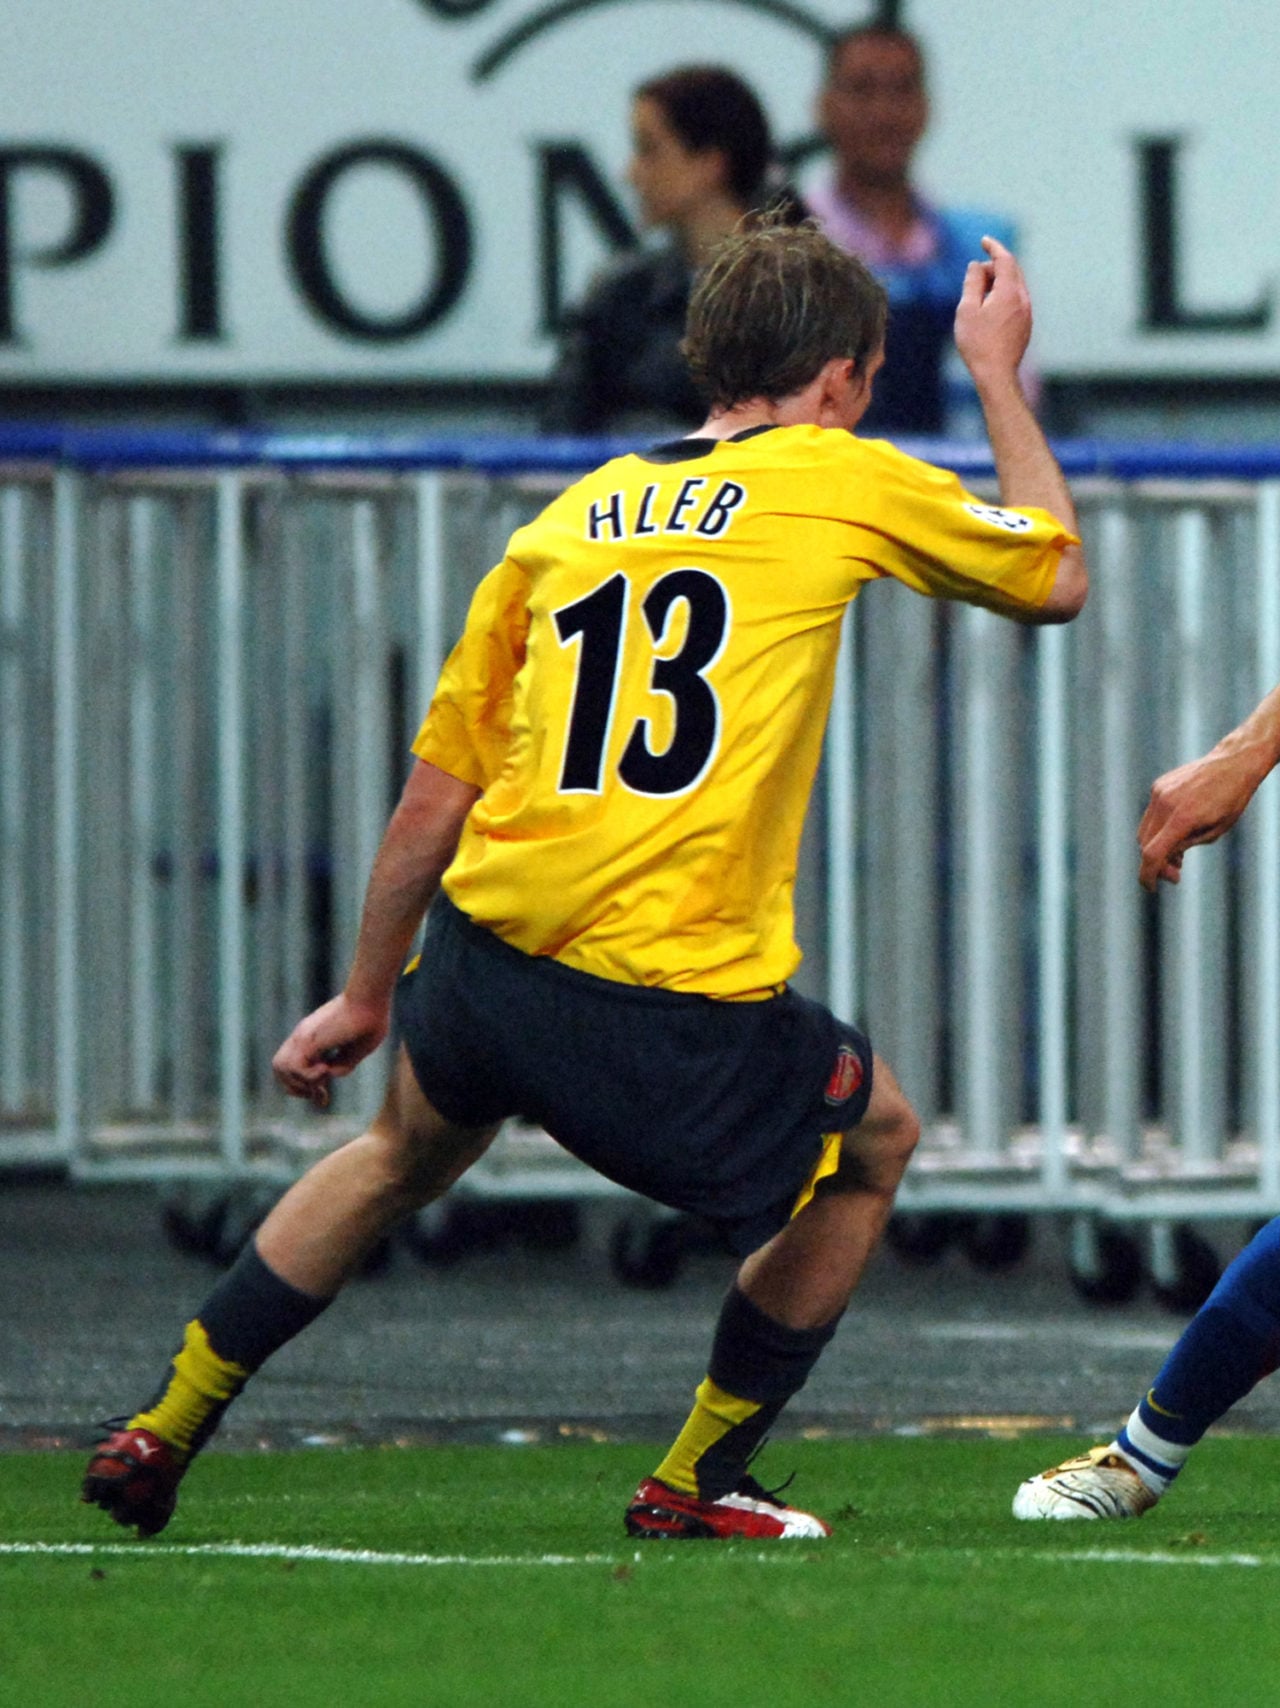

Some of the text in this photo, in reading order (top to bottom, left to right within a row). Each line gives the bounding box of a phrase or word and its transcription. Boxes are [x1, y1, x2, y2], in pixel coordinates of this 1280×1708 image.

[0, 139, 833, 345] PION
[587, 477, 746, 542] HLEB
[551, 568, 732, 799] 13
